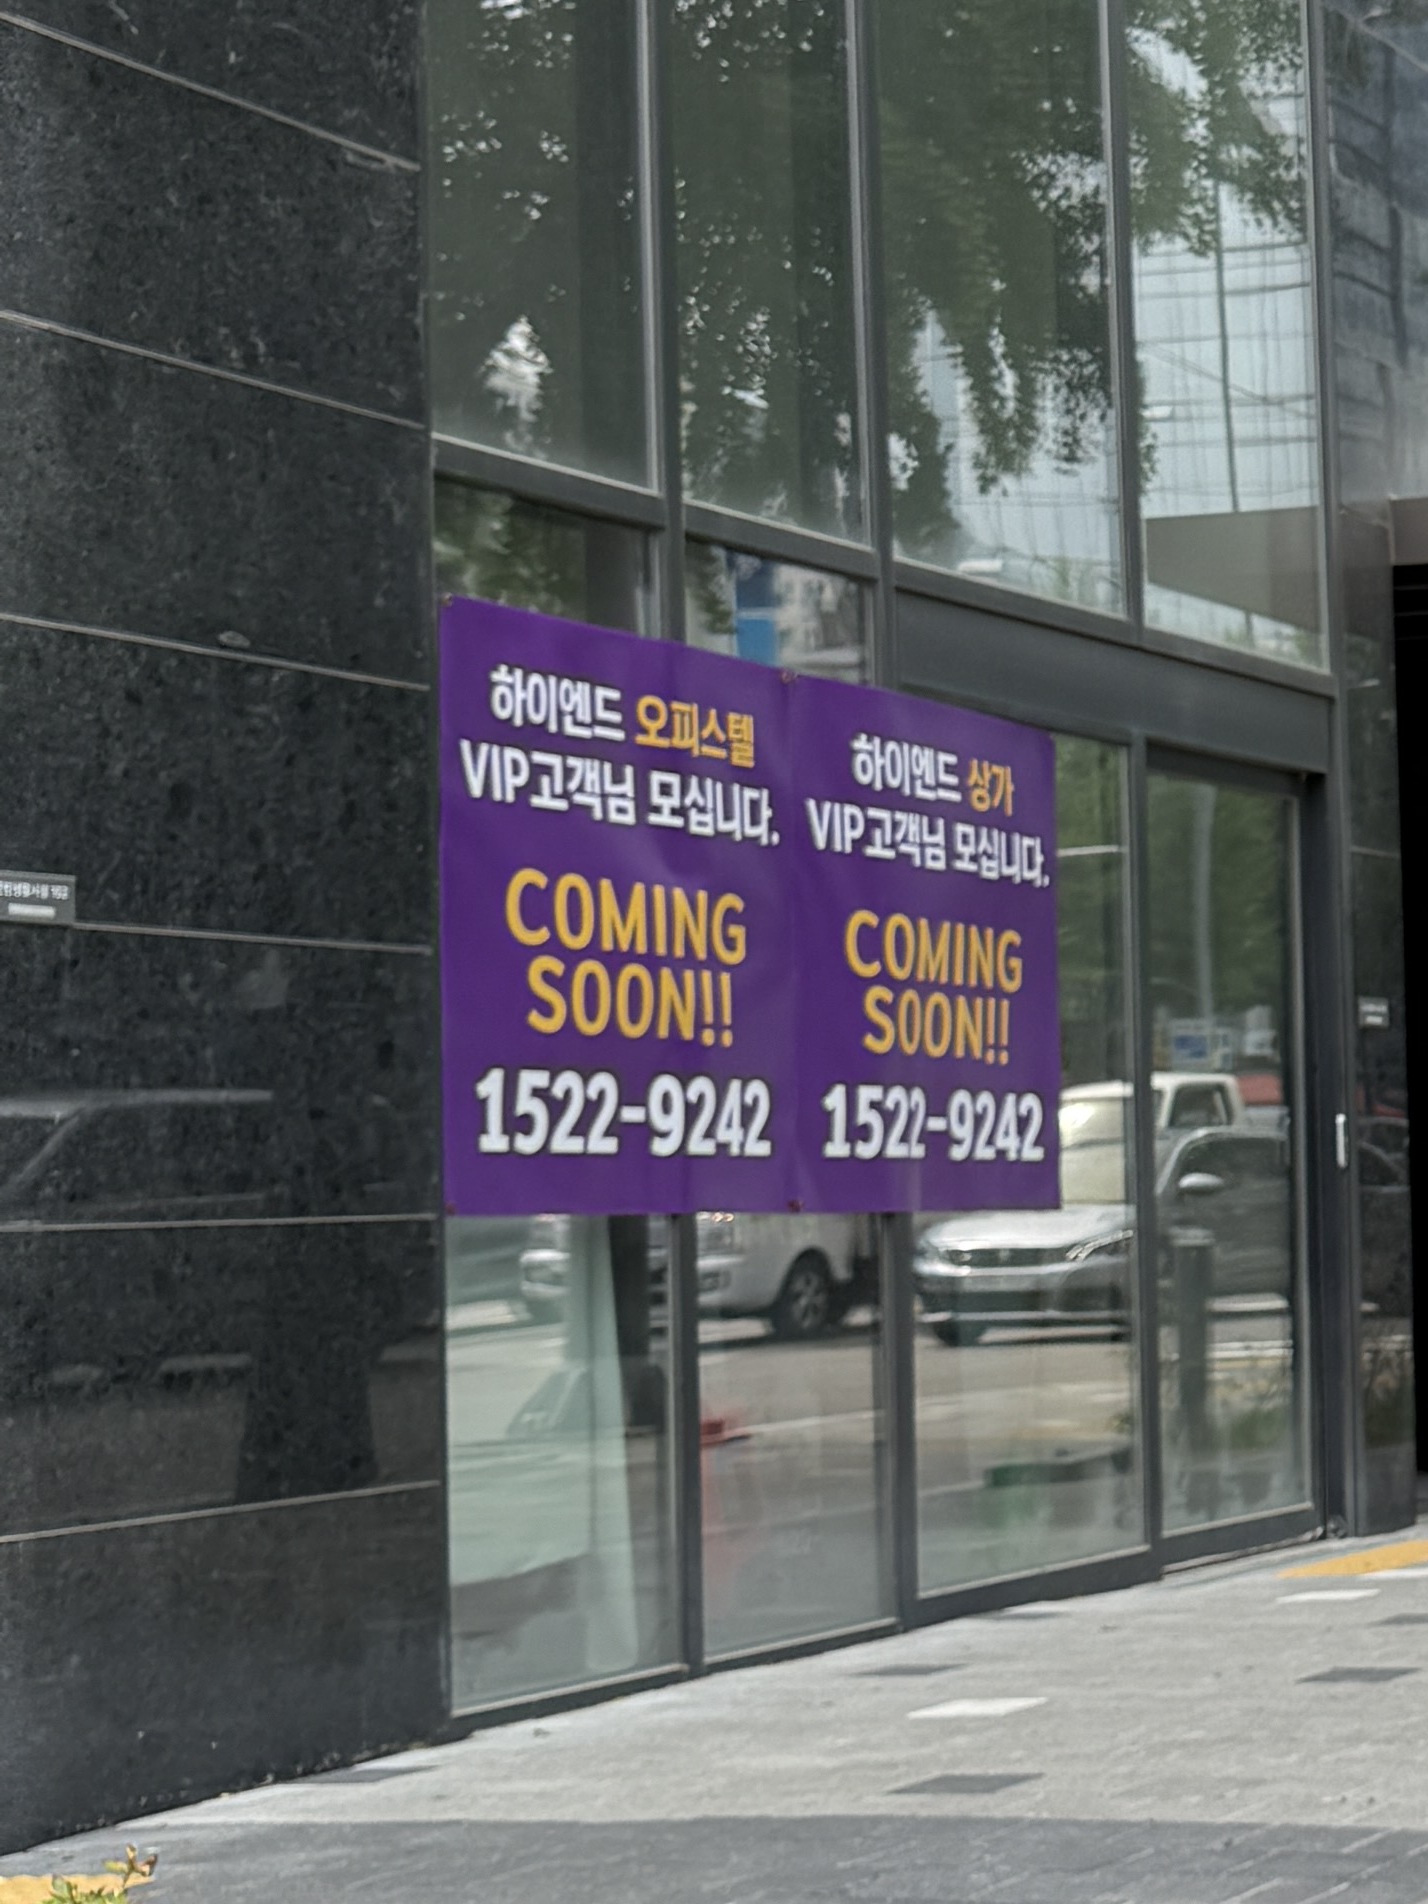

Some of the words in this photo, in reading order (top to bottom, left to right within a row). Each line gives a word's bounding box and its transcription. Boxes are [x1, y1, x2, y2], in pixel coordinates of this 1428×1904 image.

[489, 663, 625, 741] 하이엔드
[635, 694, 756, 769] 오피스텔
[459, 738, 636, 826] VIP고객님
[649, 771, 780, 846] 모십니다.
[850, 733, 962, 803] 하이엔드
[968, 758, 1014, 817] 상가
[806, 797, 947, 872] VIP고객님
[952, 822, 1050, 888] 모십니다.
[506, 867, 747, 965] COMING
[844, 909, 1022, 993] COMING
[527, 956, 733, 1048] SOON!!
[863, 985, 1009, 1065] SOON!!
[475, 1067, 772, 1158] 1522-9242
[822, 1083, 1044, 1162] 1522-9242
